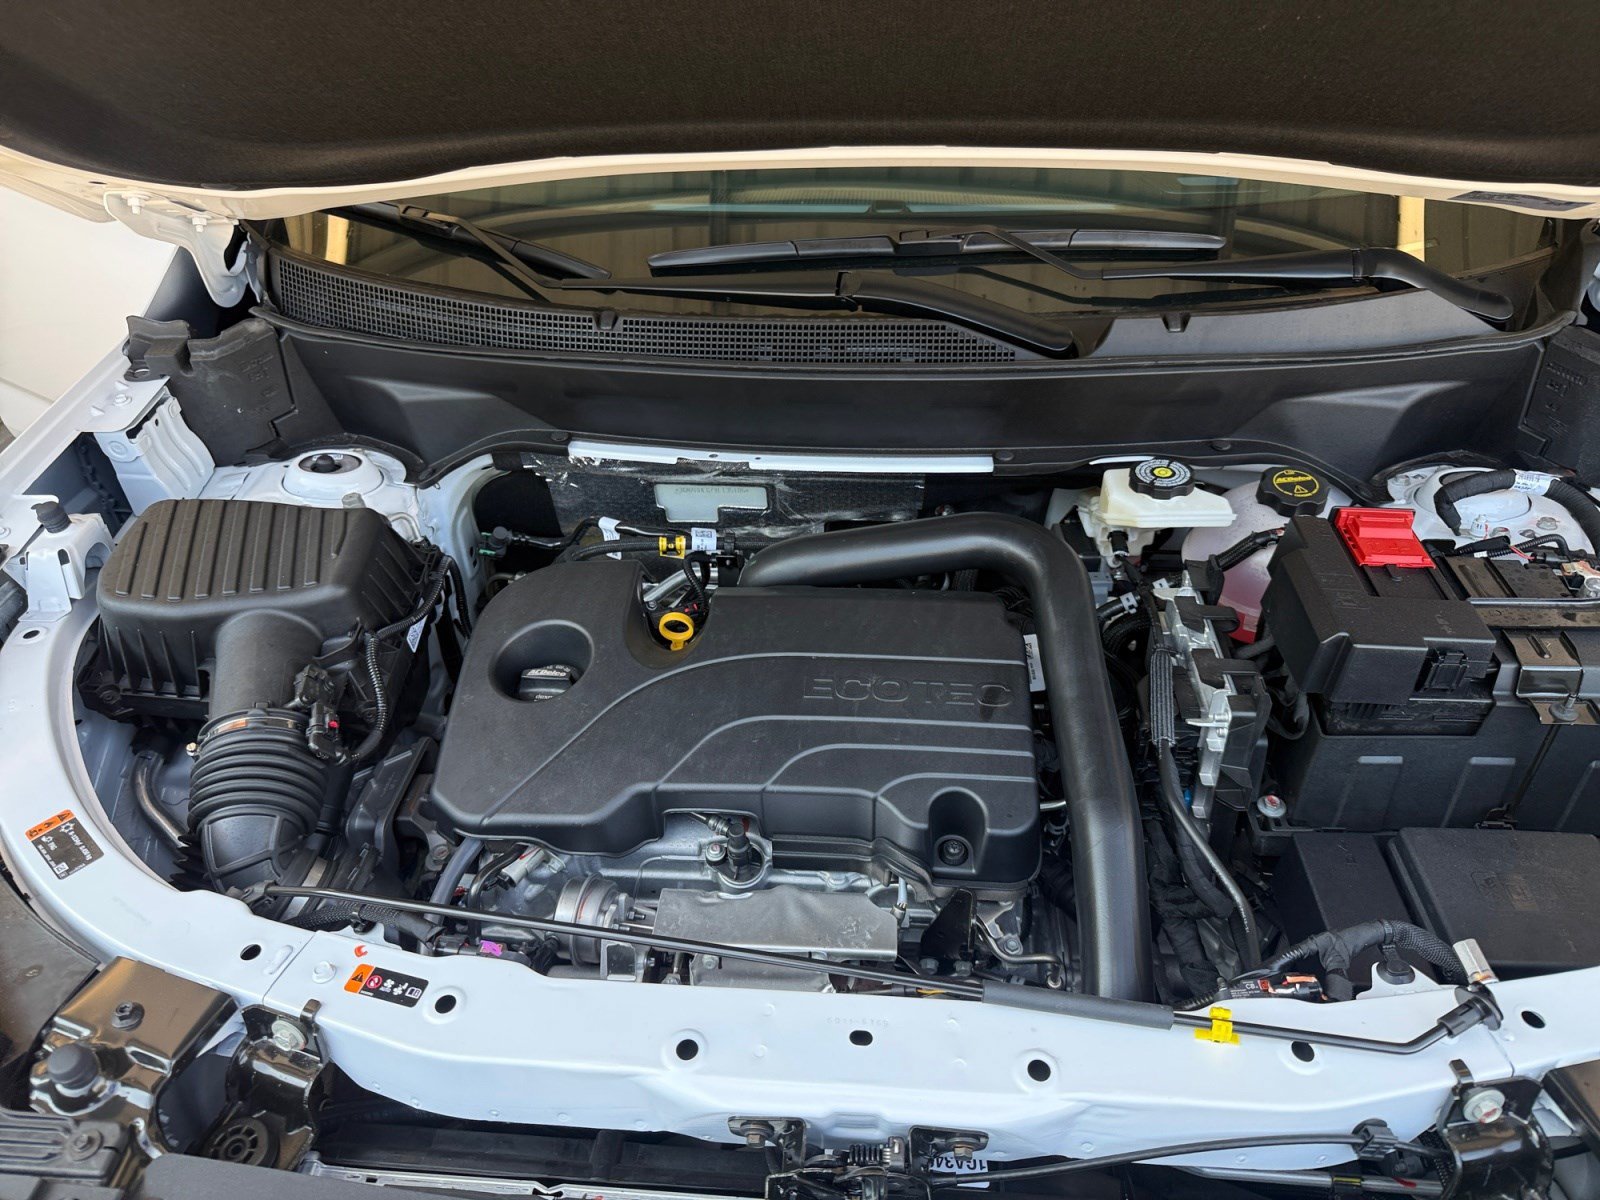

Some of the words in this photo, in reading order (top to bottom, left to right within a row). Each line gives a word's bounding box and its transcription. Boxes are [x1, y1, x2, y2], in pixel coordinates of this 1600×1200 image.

[1276, 476, 1312, 484] ACDelco
[526, 669, 567, 677] ACDelco
[803, 678, 1011, 707] ECOTEC
